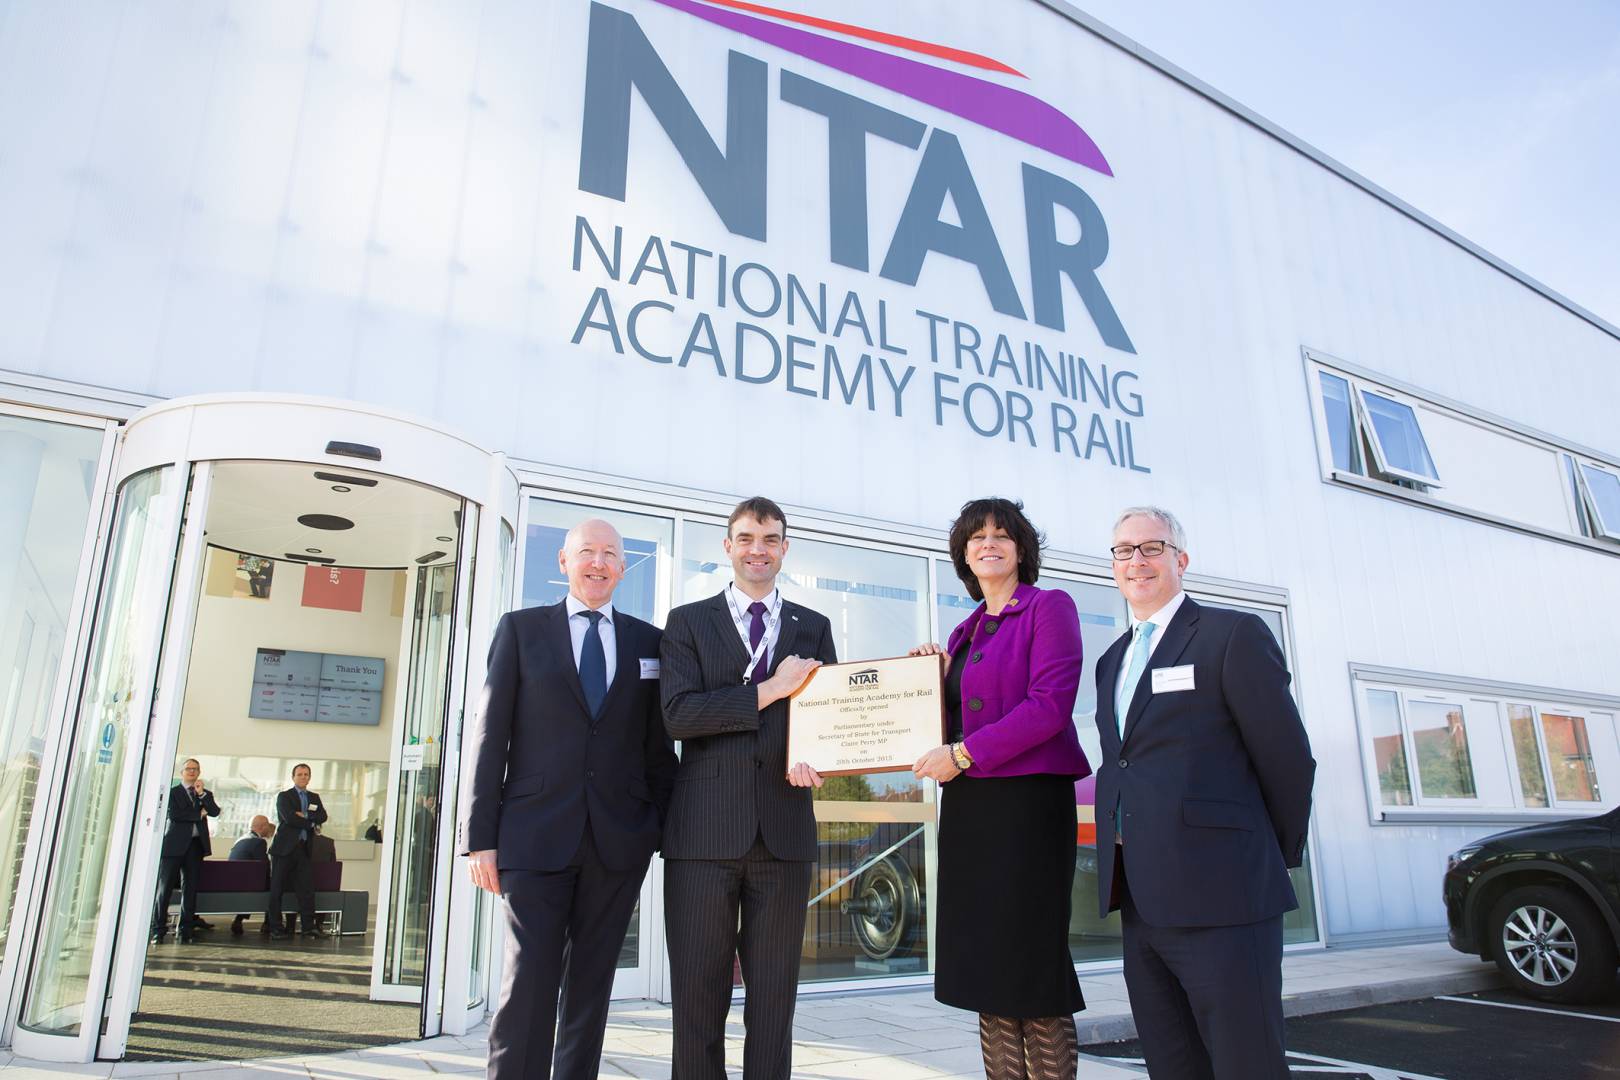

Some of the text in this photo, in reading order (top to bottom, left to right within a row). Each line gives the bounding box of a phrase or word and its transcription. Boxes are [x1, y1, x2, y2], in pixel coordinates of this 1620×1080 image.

[578, 0, 1138, 355] NTAR
[572, 215, 1145, 418] NATIONAL TRAINING
[571, 286, 1151, 475] ACADEMY FOR RAIL
[336, 665, 378, 675] Thank You
[849, 674, 879, 686] NTAR
[798, 688, 933, 708] National Training Academy for Rail
[866, 703, 889, 711] opened
[833, 721, 875, 731] Parliamentary
[818, 732, 845, 741] Secretary
[881, 727, 911, 736] Transport
[860, 738, 876, 746] Perry
[851, 757, 875, 765] October
